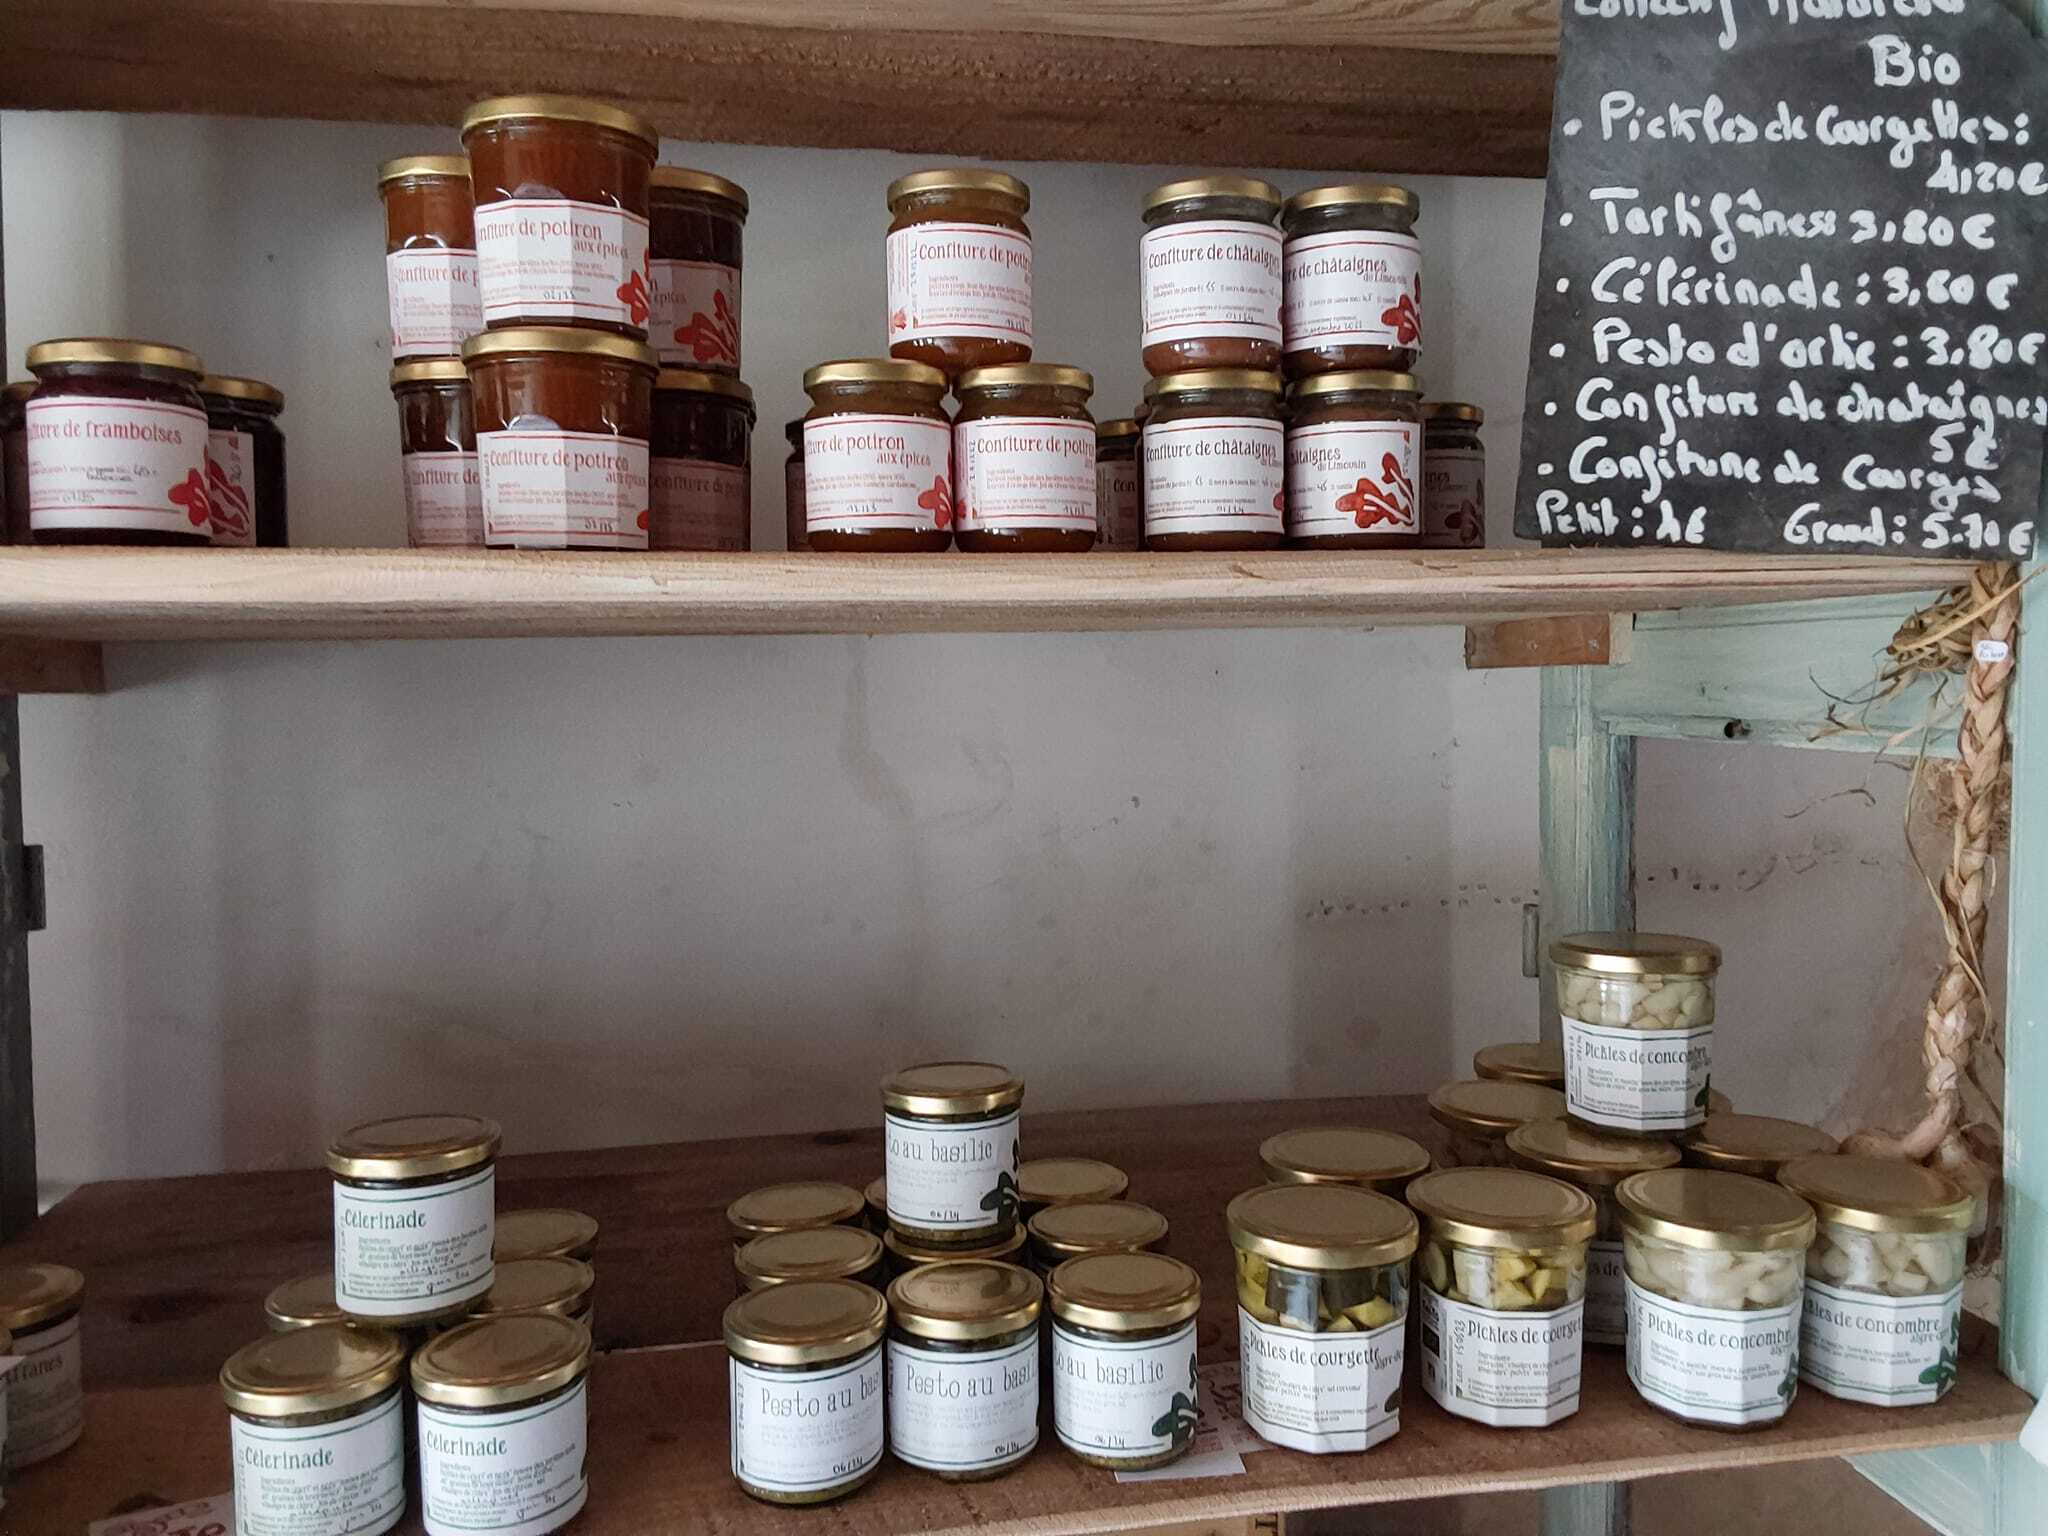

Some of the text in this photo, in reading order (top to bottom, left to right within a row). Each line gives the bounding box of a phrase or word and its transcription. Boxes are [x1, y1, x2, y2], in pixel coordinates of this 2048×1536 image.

[1869, 34, 1961, 87] Bio
[1600, 90, 1758, 144] Pickles
[1764, 101, 1807, 142] de
[519, 217, 536, 236] de
[541, 217, 603, 241] potiron
[920, 241, 986, 261] Confiture
[989, 243, 1005, 263] de
[1149, 245, 1203, 269] Confiture
[1207, 243, 1223, 261] de
[451, 265, 468, 283] de
[1299, 261, 1312, 280] de
[1314, 256, 1388, 276] châtaignes
[1592, 317, 1716, 367] Pesto
[1575, 376, 1759, 446] Confiture
[1776, 380, 1826, 422] de
[63, 418, 81, 438] de
[86, 419, 183, 446] framboises
[829, 434, 842, 453] de
[846, 432, 905, 456] potiron
[977, 435, 1042, 455] Confiture
[1045, 435, 1061, 453] de
[489, 449, 548, 468] Confiture
[552, 448, 570, 467] de
[876, 452, 897, 465] aux
[1146, 440, 1193, 462] Confiture
[1195, 440, 1212, 457] de
[1569, 436, 2001, 513] Confiture de Courges
[1536, 489, 1620, 537] Petit
[1585, 1041, 1627, 1062] Pickles
[1629, 1050, 1645, 1065] de
[902, 1140, 922, 1160] au
[931, 1138, 993, 1163] basilic
[1467, 1319, 1518, 1344] Pickles
[1521, 1325, 1539, 1345] de
[1648, 1311, 1694, 1344] Pickles
[1697, 1329, 1716, 1346] de
[1834, 1310, 1853, 1328] de
[1855, 1316, 1940, 1335] concombre
[1249, 1329, 1287, 1362] Pickles
[1290, 1345, 1308, 1366] de
[906, 1363, 960, 1400] Pesto
[967, 1375, 993, 1398] au
[1067, 1353, 1087, 1379] au
[1096, 1354, 1165, 1386] basilic
[761, 1387, 820, 1418] Pesto
[827, 1387, 852, 1413] au
